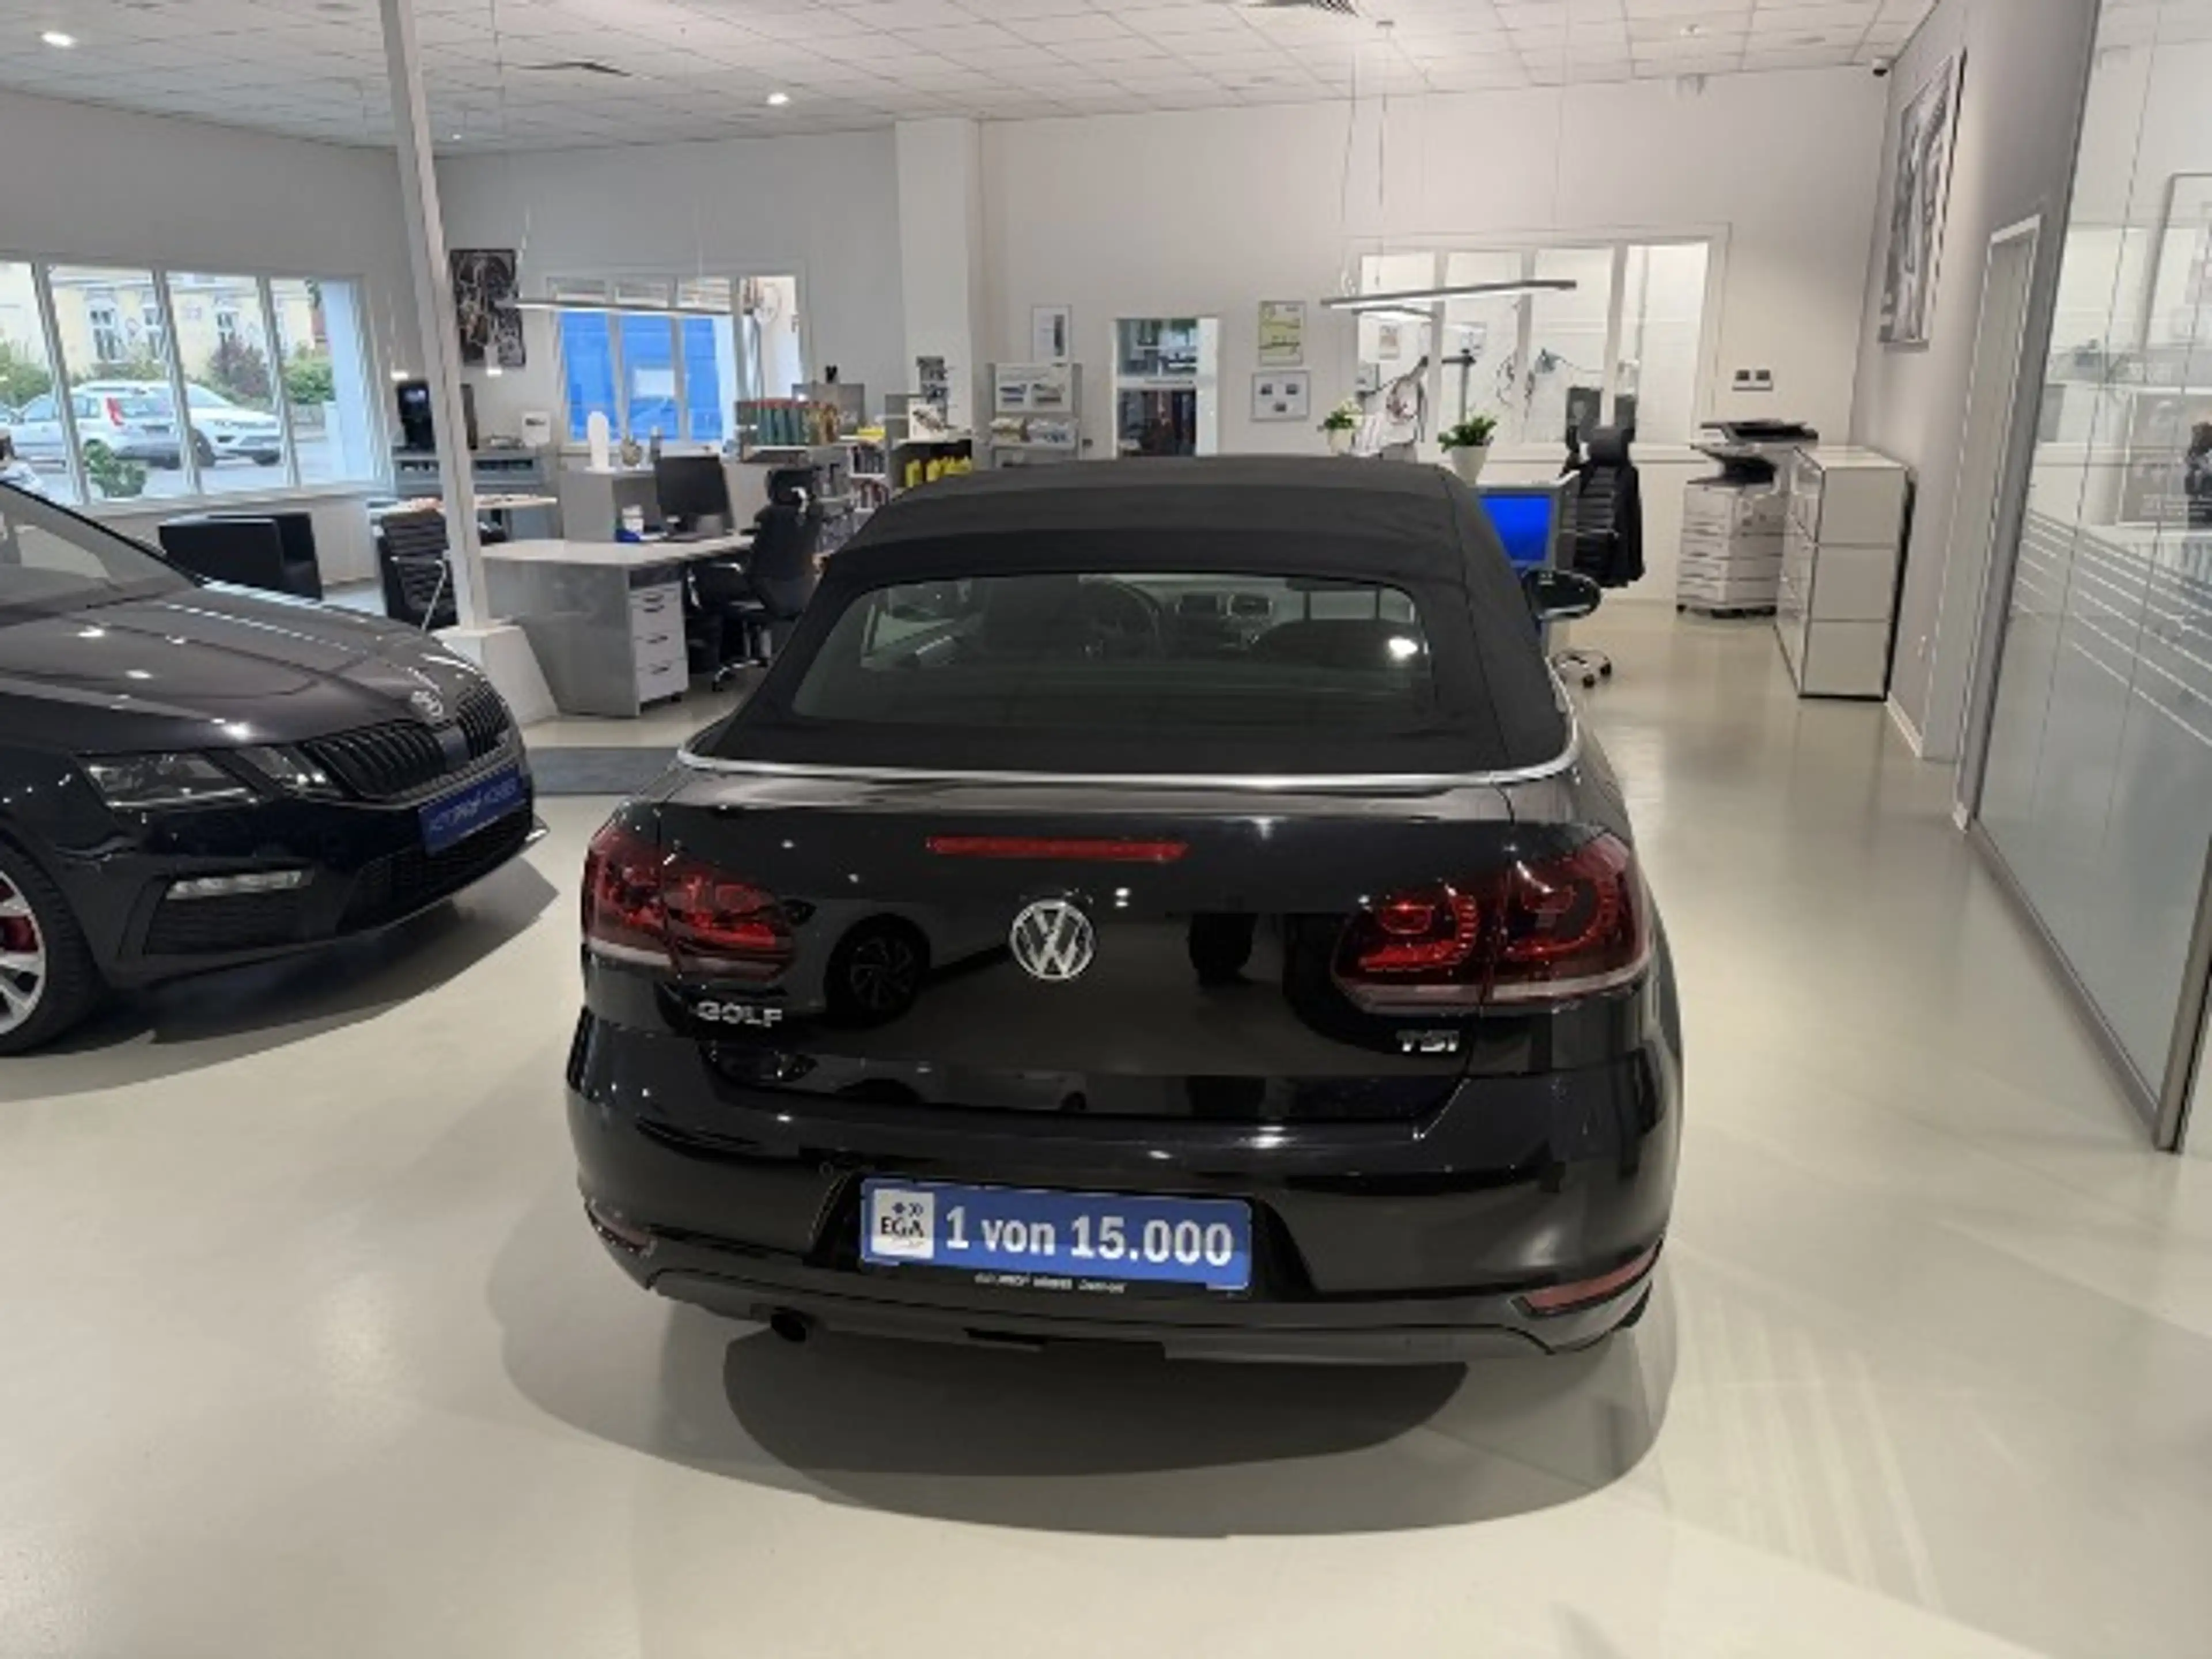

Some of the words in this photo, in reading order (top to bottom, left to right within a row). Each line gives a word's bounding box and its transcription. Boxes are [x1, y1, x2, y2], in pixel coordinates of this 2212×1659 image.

[697, 1001, 782, 1028] GOLF
[881, 1215, 925, 1238] EGA
[946, 1205, 969, 1249] 1
[981, 1219, 1055, 1255] von
[1071, 1215, 1232, 1266] 15.000
